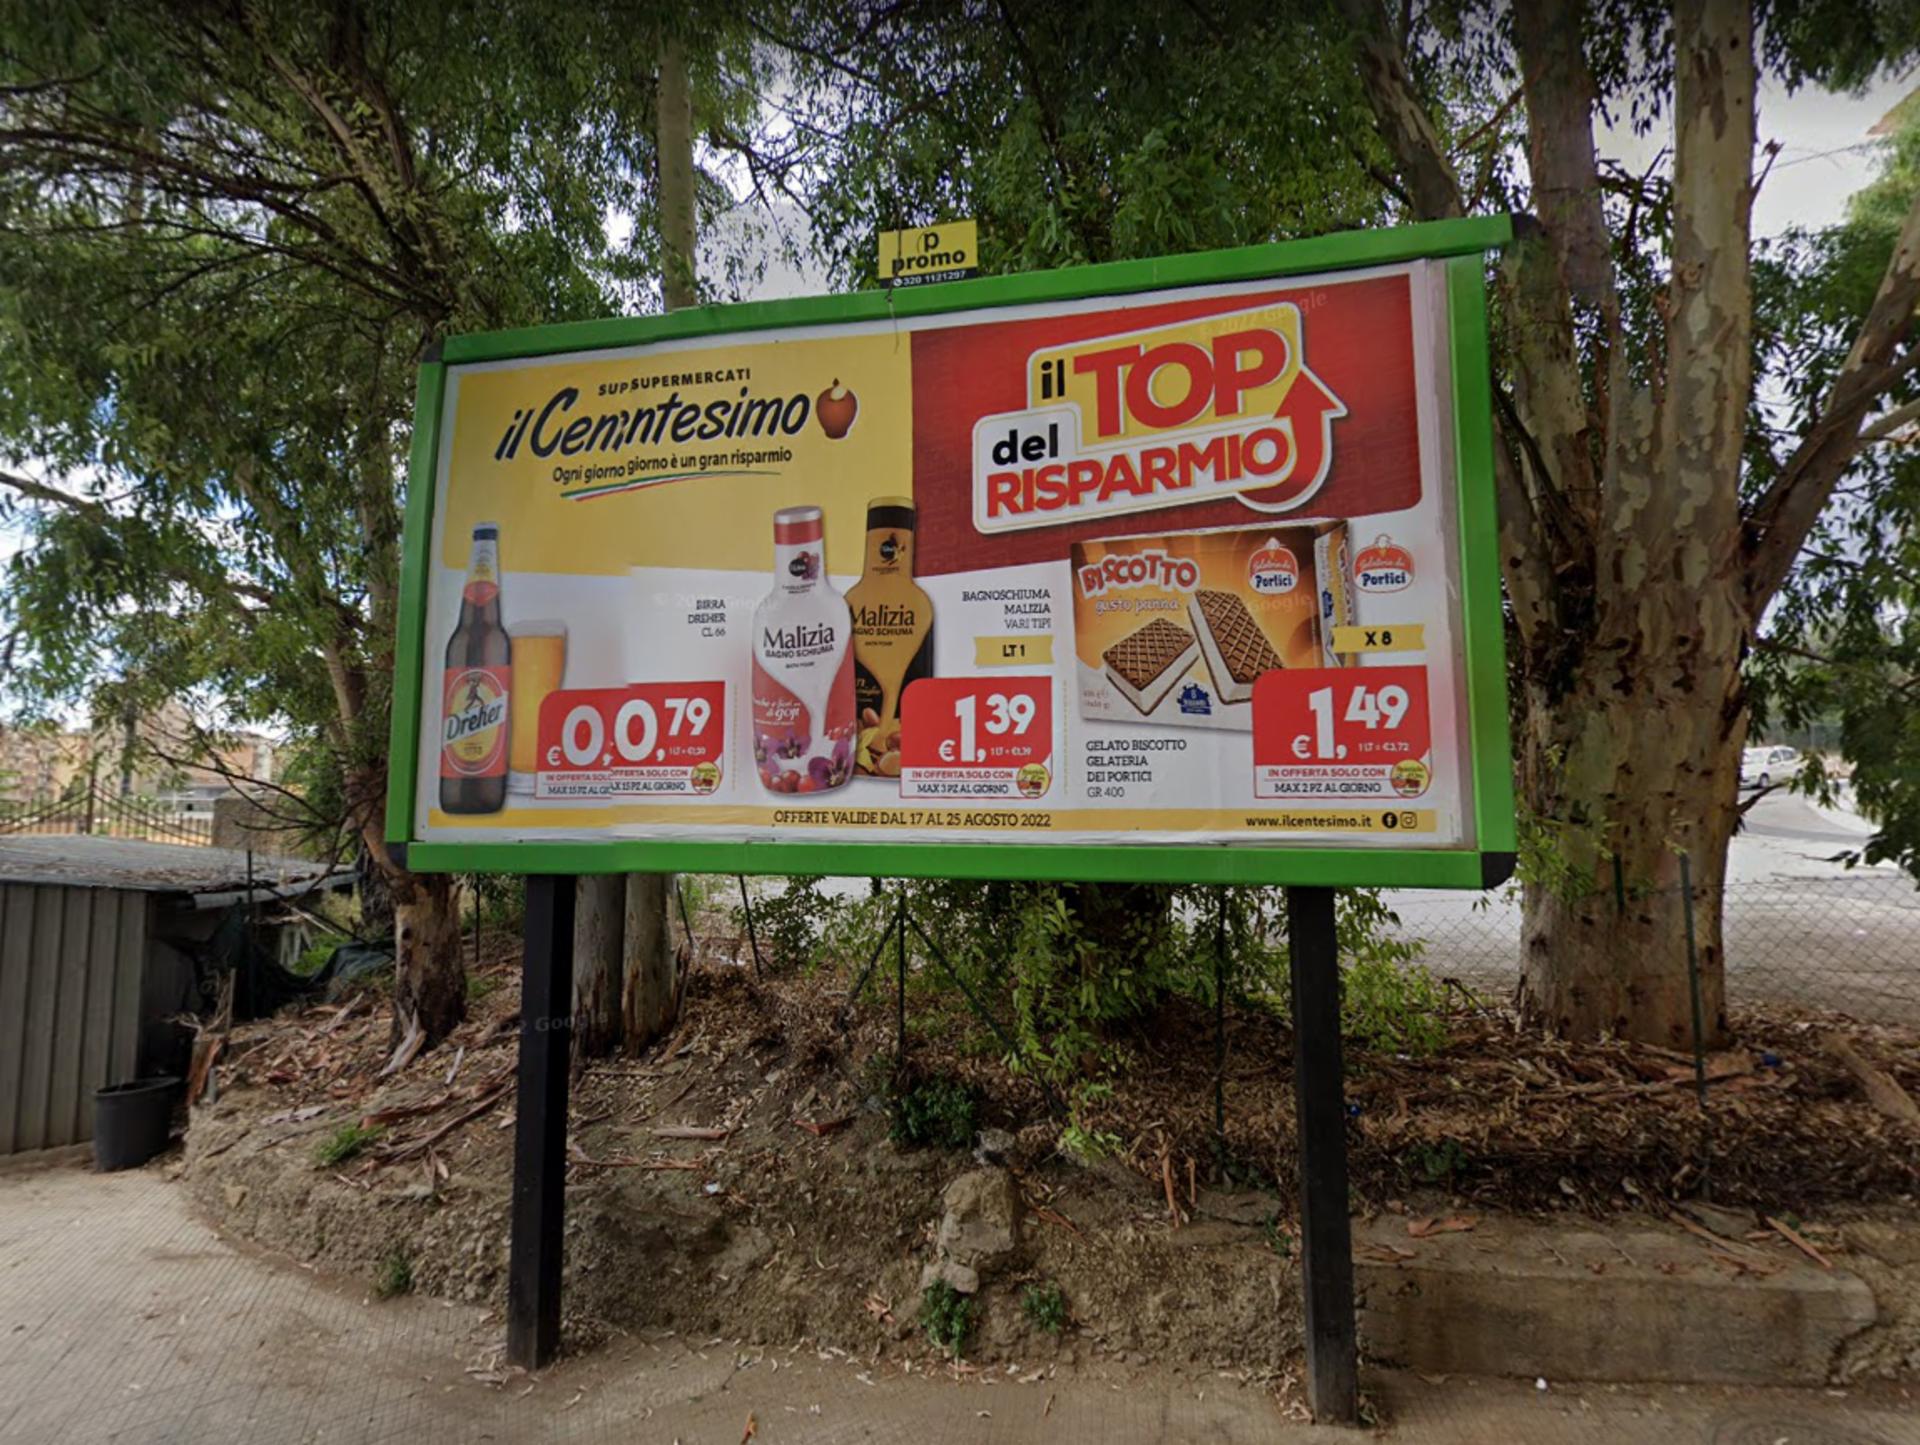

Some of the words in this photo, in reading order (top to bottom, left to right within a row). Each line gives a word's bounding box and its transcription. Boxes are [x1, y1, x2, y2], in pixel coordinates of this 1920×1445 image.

[892, 249, 966, 275] promo
[1040, 358, 1066, 400] il
[1073, 327, 1288, 438] TOP
[494, 408, 535, 461] il
[991, 423, 1059, 466] del
[552, 465, 583, 485] Ogni
[584, 465, 625, 484] giorno
[627, 456, 668, 476] giorno
[670, 453, 678, 469] è
[680, 455, 697, 468] un
[699, 453, 729, 471] gran
[731, 446, 793, 468] risparmio
[986, 427, 1290, 519] RISPARMIO
[1082, 554, 1198, 593] BISCOTTO
[1361, 571, 1406, 587] Portici
[962, 589, 1051, 602] BAGNOSCHIUMA
[696, 599, 726, 610] BIRRA
[1004, 604, 1051, 615] MALIZIA
[688, 613, 726, 624] DREHER
[849, 604, 915, 627] Malizia
[1004, 618, 1030, 629] VARI
[1031, 617, 1051, 629] TIPI
[701, 627, 713, 637] CL
[714, 627, 726, 637] 66
[763, 622, 835, 650] Malizia
[1365, 631, 1377, 646] X
[1382, 631, 1392, 645] 8
[1002, 644, 1019, 657] LT
[1020, 643, 1025, 657] 1
[446, 703, 504, 740] Dreher
[1086, 740, 1130, 751] GELATO
[1131, 739, 1187, 751] BISCOTTO
[1086, 755, 1148, 767] GELATERIA
[923, 770, 963, 779] OFFERTA
[966, 770, 992, 779] SOLO
[993, 770, 1014, 779] CON
[1087, 770, 1106, 782] DEI
[1107, 770, 1152, 782] PORTICI
[1268, 768, 1279, 777] IN
[1281, 768, 1328, 777] OFFERTA
[1331, 768, 1360, 777] SOLO
[1362, 768, 1386, 777] CON
[917, 784, 939, 794] MAX
[972, 784, 1009, 794] GIORNO
[1087, 786, 1102, 797] GR
[1103, 786, 1125, 797] 400
[1274, 783, 1301, 793] MAX
[1309, 783, 1323, 793] PZ
[1324, 783, 1338, 793] AL
[1339, 783, 1381, 793] GIORNO
[774, 810, 829, 824] OFFERTE
[831, 811, 878, 825] VALIDE
[880, 811, 907, 825] DAL
[909, 811, 923, 824] 17
[925, 812, 944, 825] AL
[946, 812, 961, 825] 25
[963, 812, 1019, 826] AGOSTO
[1021, 813, 1051, 827] 2022
[1246, 814, 1372, 828] www.ilcentesimo.it
